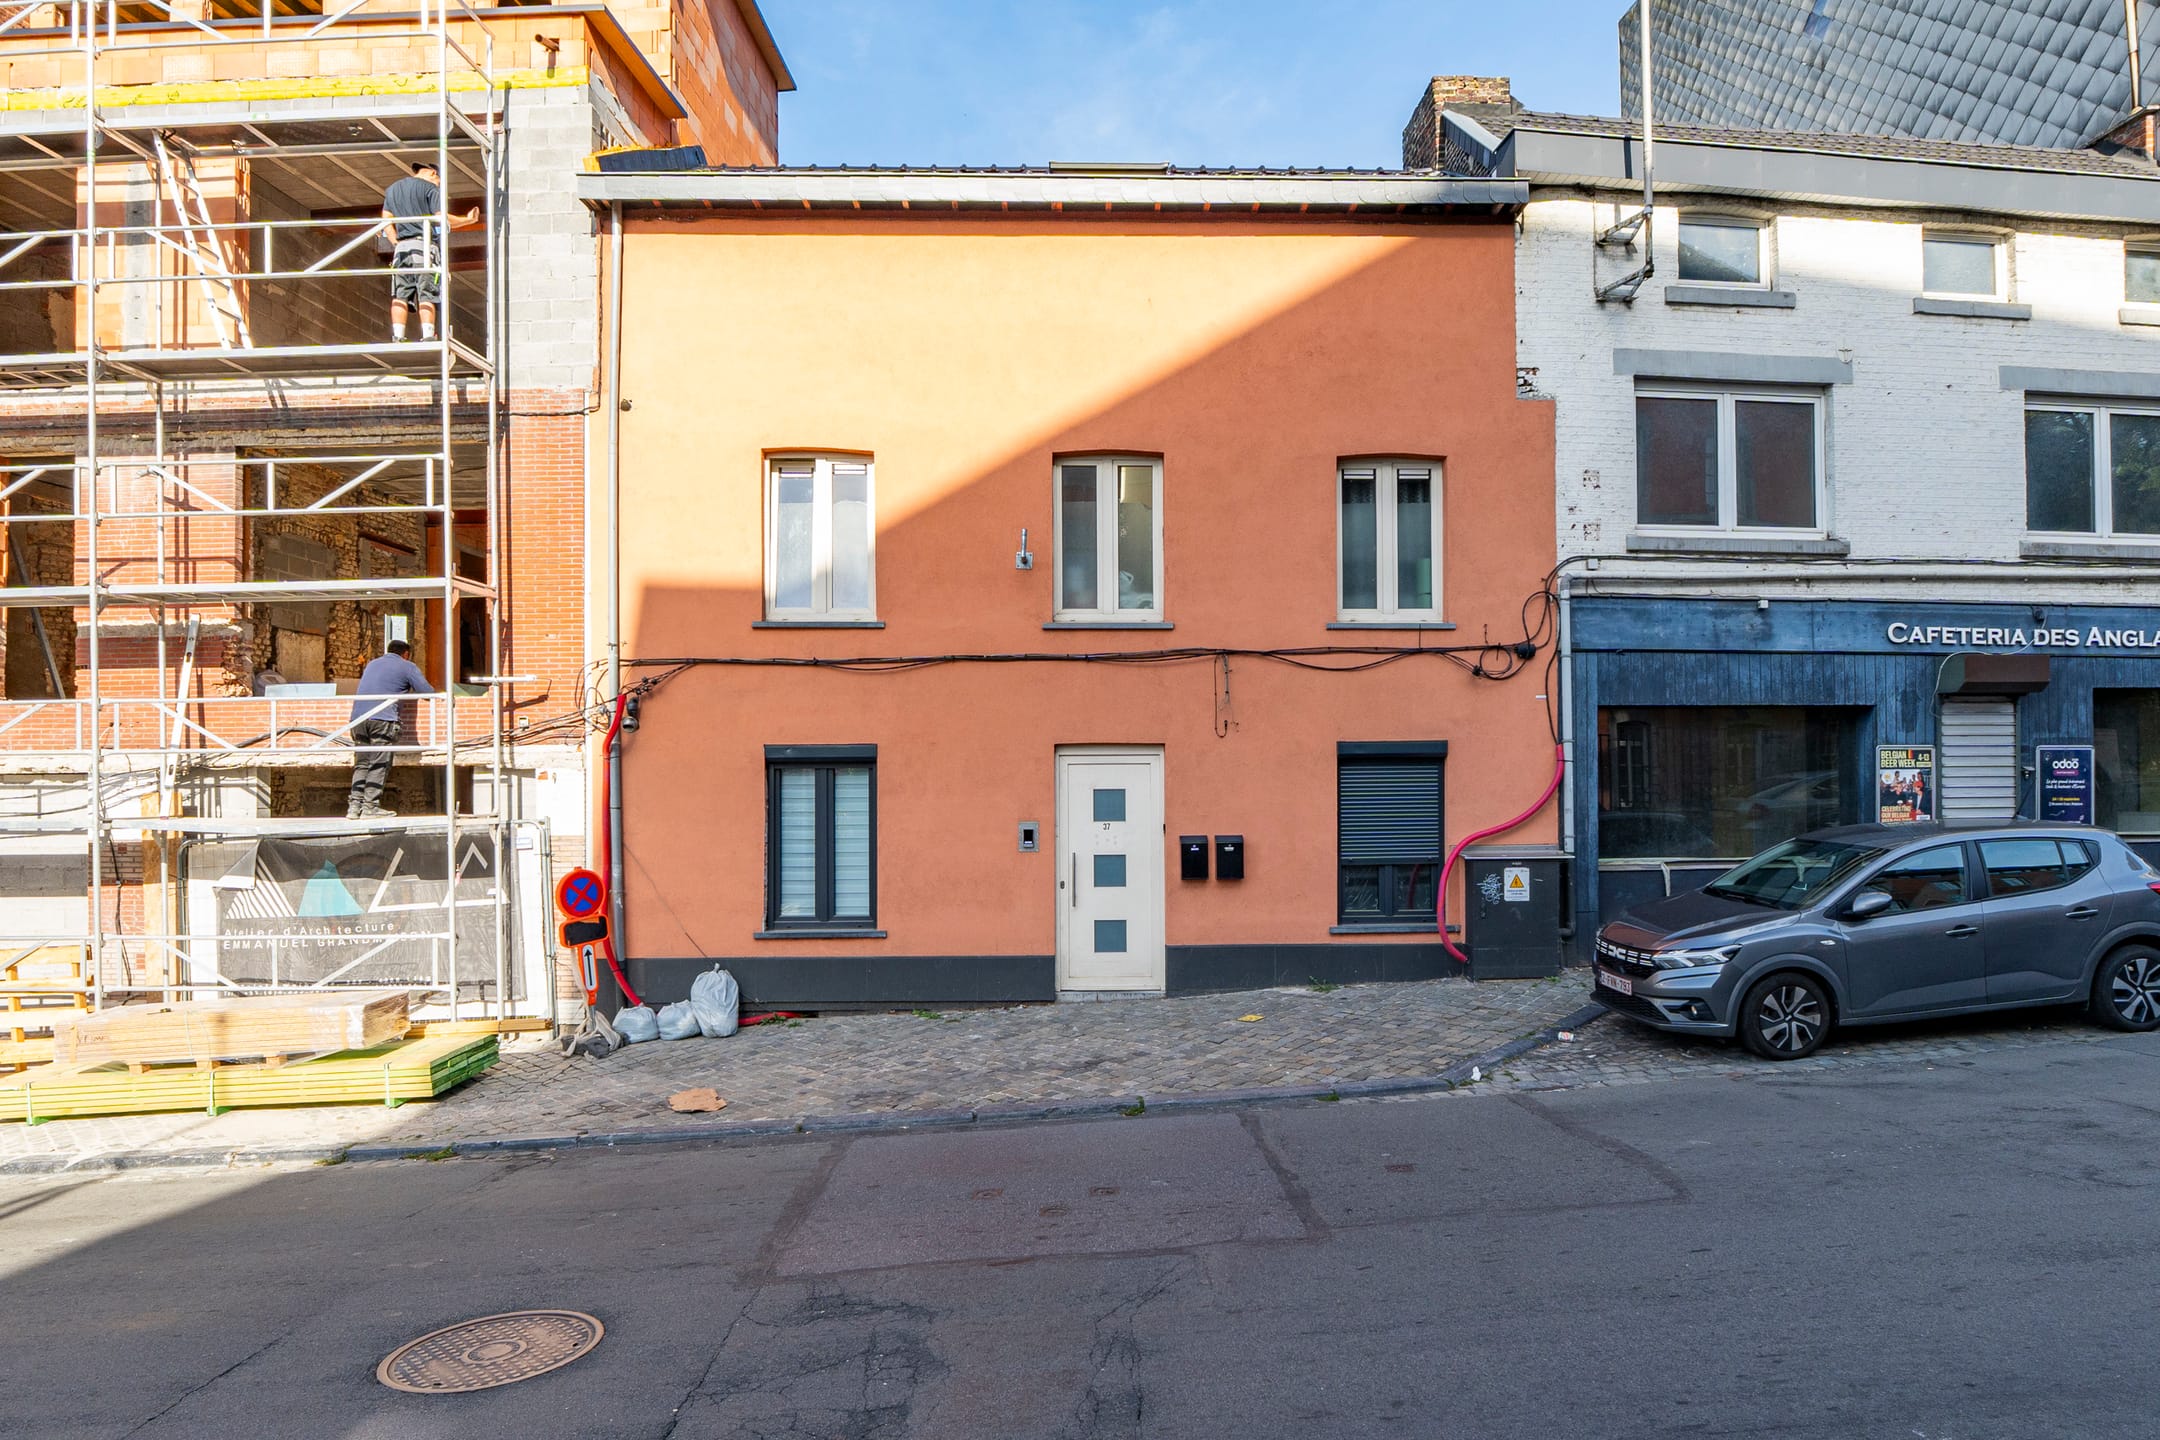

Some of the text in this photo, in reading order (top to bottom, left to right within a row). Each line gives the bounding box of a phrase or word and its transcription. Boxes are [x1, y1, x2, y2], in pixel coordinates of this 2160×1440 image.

[1887, 622, 2027, 646] CAFETERIA
[2033, 628, 2080, 647] DES
[1880, 750, 1907, 759] BELGIAN
[1880, 759, 1897, 768] BEER
[1898, 759, 1916, 768] WEEK
[1102, 822, 1110, 830] 37
